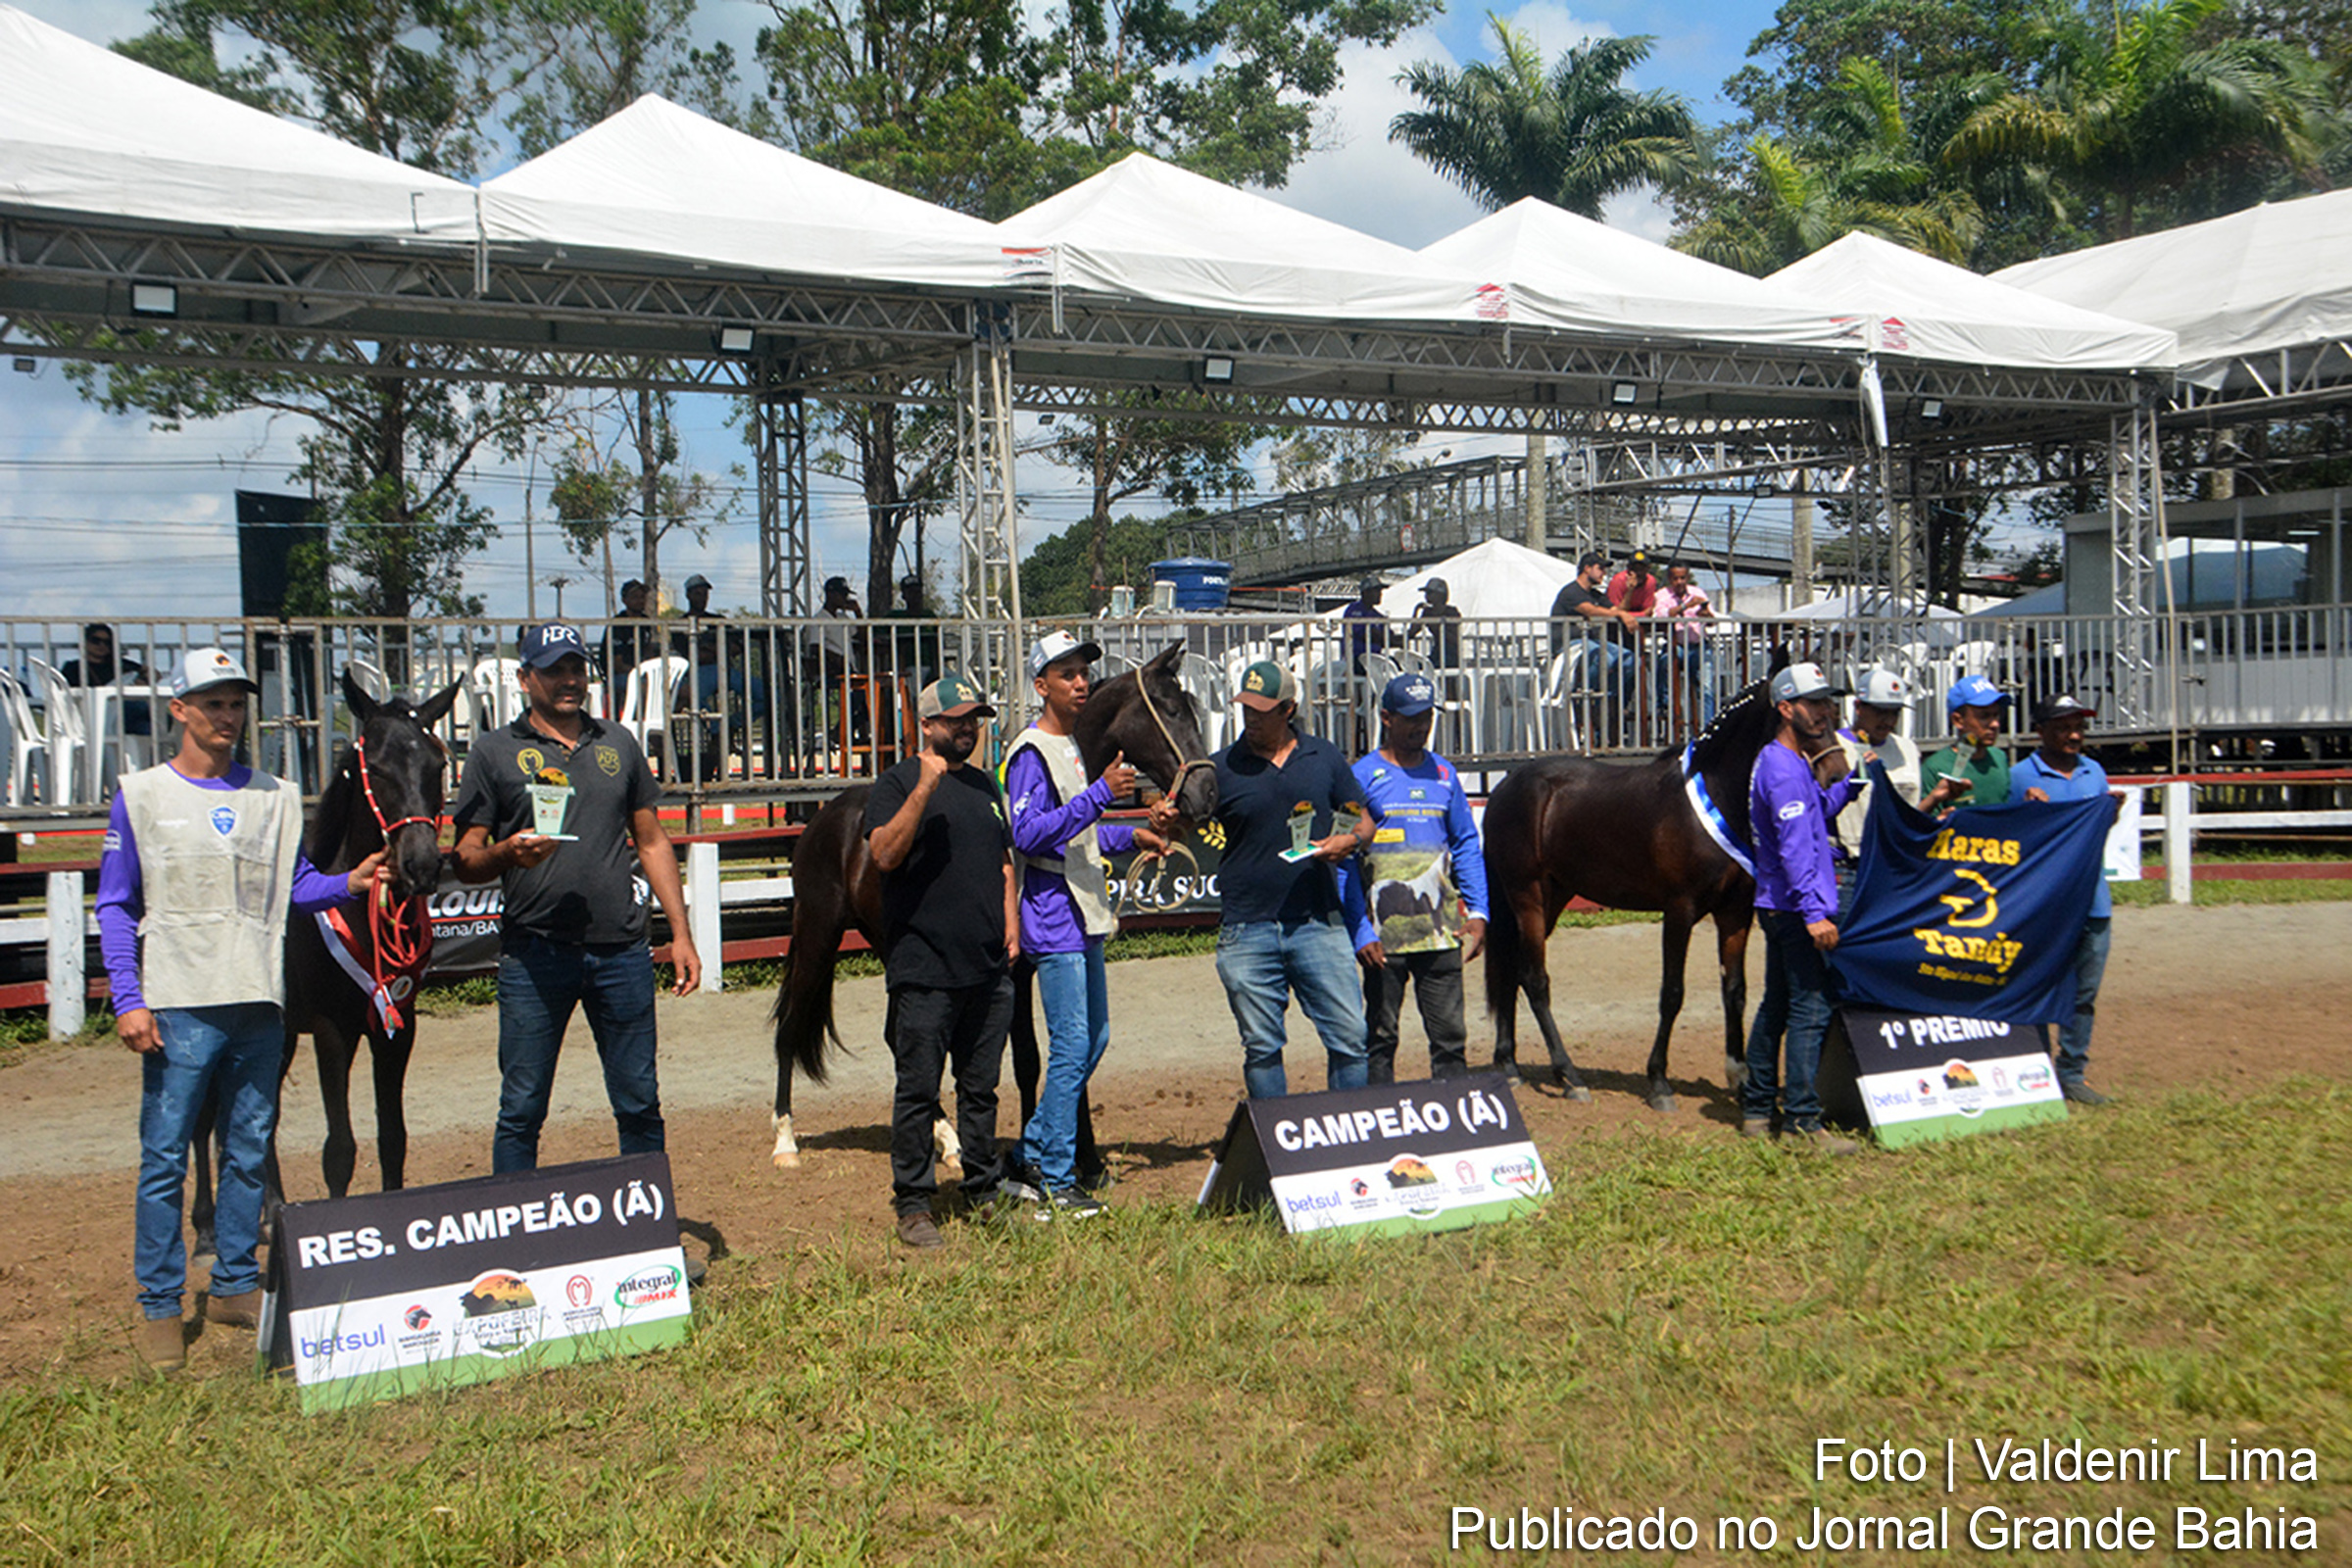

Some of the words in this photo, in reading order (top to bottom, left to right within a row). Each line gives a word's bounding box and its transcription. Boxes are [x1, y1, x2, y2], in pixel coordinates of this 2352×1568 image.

[1274, 1098, 1451, 1152] CAMPEÃO
[1457, 1089, 1509, 1136] (Ã)
[1286, 1190, 1343, 1214] betsul
[297, 1226, 396, 1269] RES.
[406, 1191, 604, 1252] CAMPEÃO
[612, 1179, 665, 1227] (Ã)
[615, 1270, 678, 1295] integral
[300, 1323, 387, 1359] betsul
